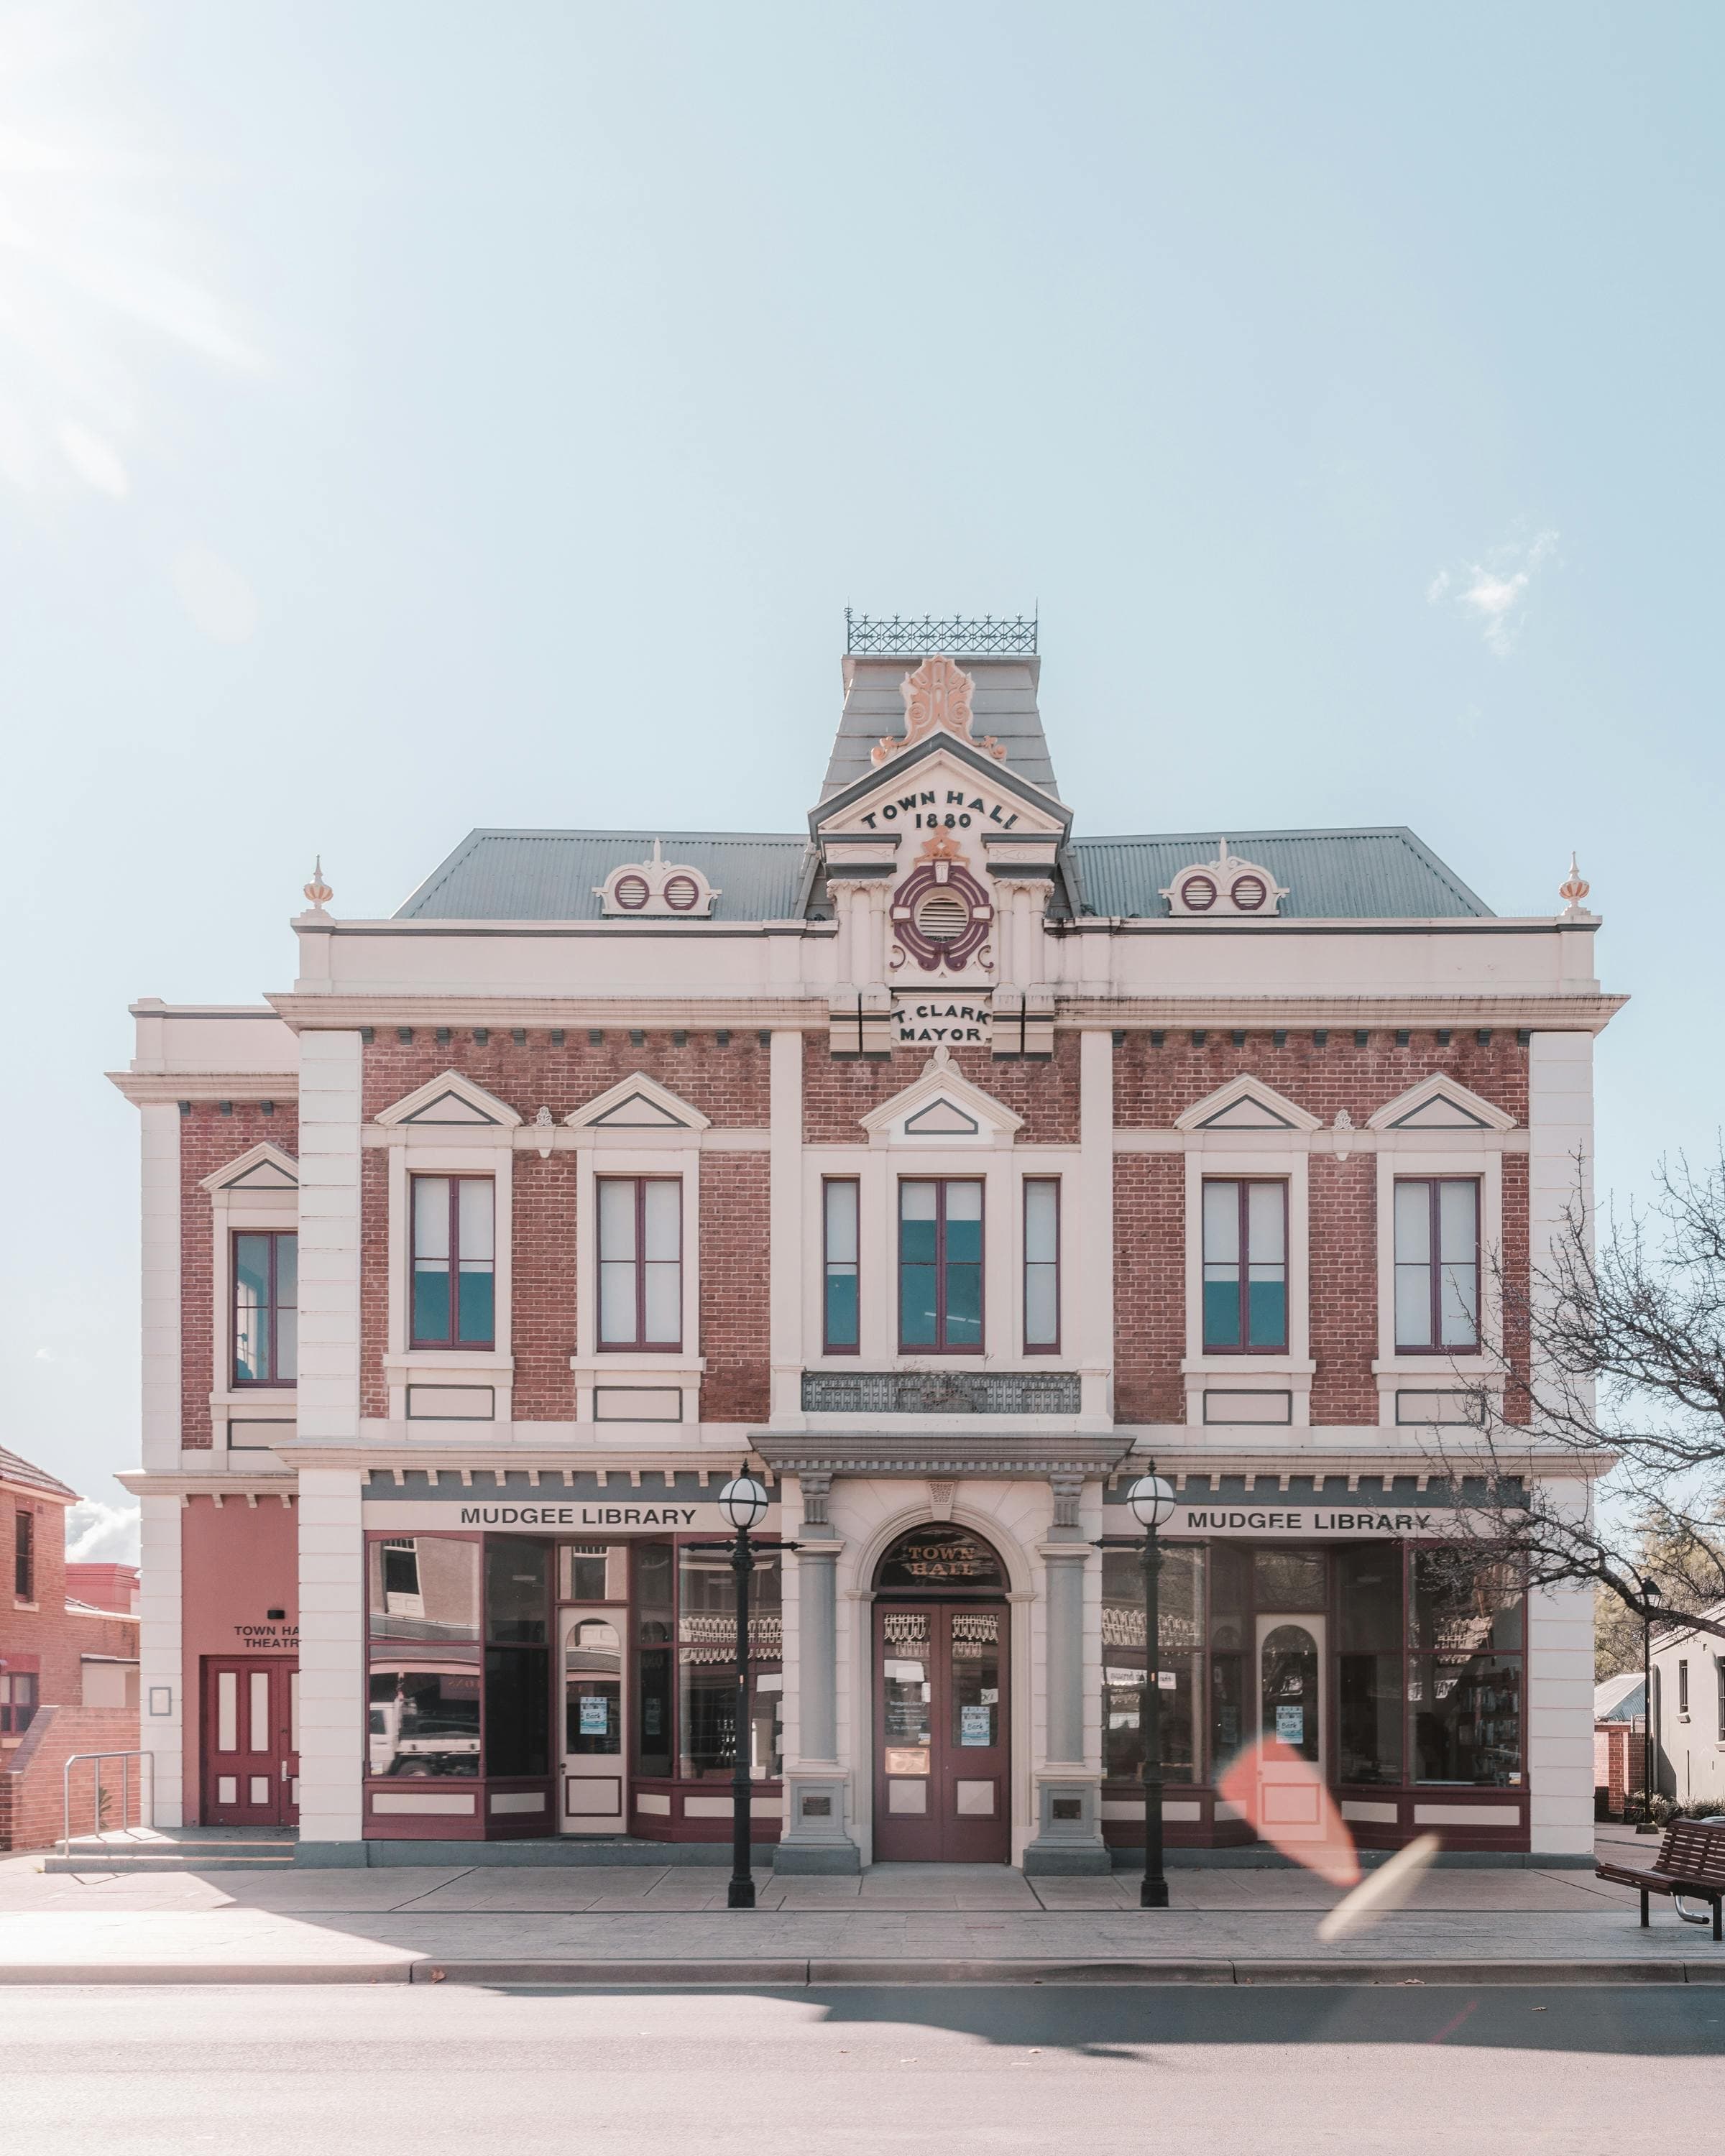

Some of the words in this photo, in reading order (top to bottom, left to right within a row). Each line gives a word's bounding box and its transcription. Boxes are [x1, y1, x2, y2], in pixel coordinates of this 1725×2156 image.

[861, 791, 935, 829] TOWN
[947, 791, 1019, 829] HALL
[916, 813, 971, 829] 1880
[891, 1010, 912, 1024] T.
[916, 1005, 992, 1025] CLARK
[900, 1028, 981, 1041] MAYOR
[461, 1508, 574, 1524] MUDGEE
[582, 1508, 696, 1525] LIBRARY
[1187, 1512, 1302, 1529] MUDGEE
[1315, 1513, 1432, 1530] LIBRARY
[908, 1547, 975, 1560] TOWN
[911, 1563, 974, 1575] HALL
[234, 1626, 276, 1636] TOWN
